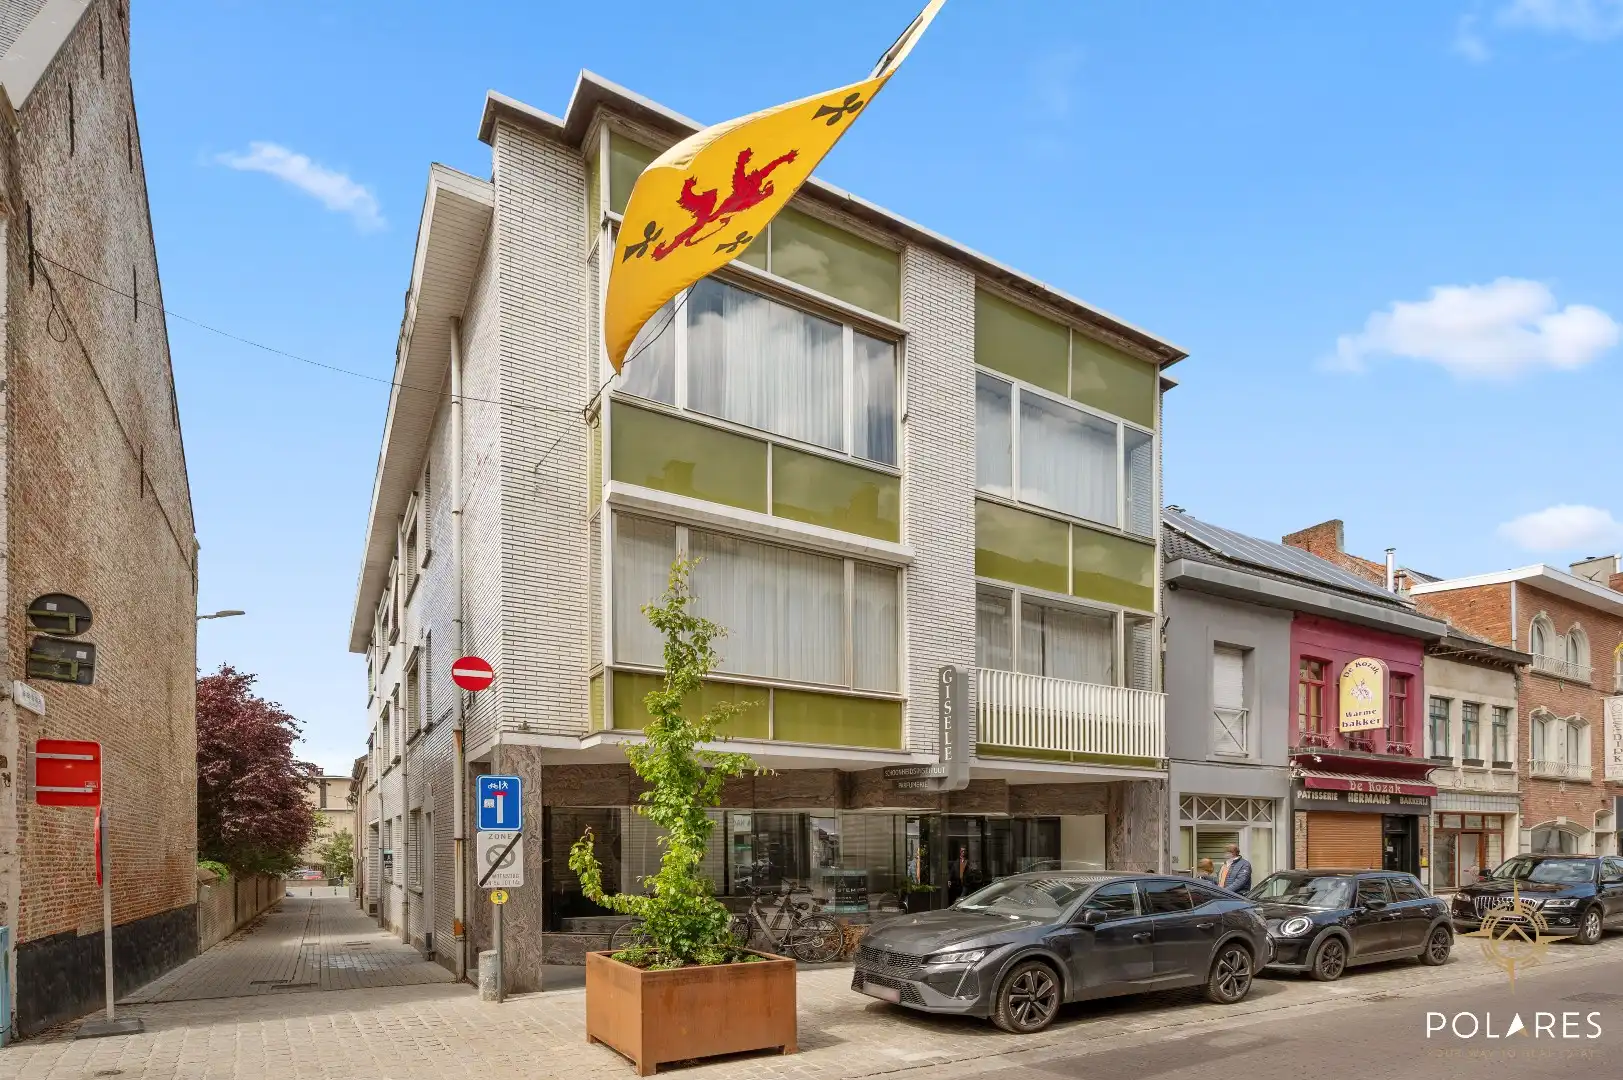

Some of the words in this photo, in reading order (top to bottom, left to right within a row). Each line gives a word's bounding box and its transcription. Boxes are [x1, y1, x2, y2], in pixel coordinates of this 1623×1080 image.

[1343, 667, 1354, 678] De
[1355, 661, 1380, 675] Kozak
[942, 669, 953, 761] GISELE
[1345, 709, 1377, 718] Warme
[1342, 718, 1381, 728] bakker
[1349, 780, 1363, 791] De
[1369, 782, 1402, 794] Kozak
[1297, 790, 1338, 801] PATISSERIE
[1348, 792, 1391, 805] HERMANS
[1400, 796, 1428, 806] BAKKERIJ
